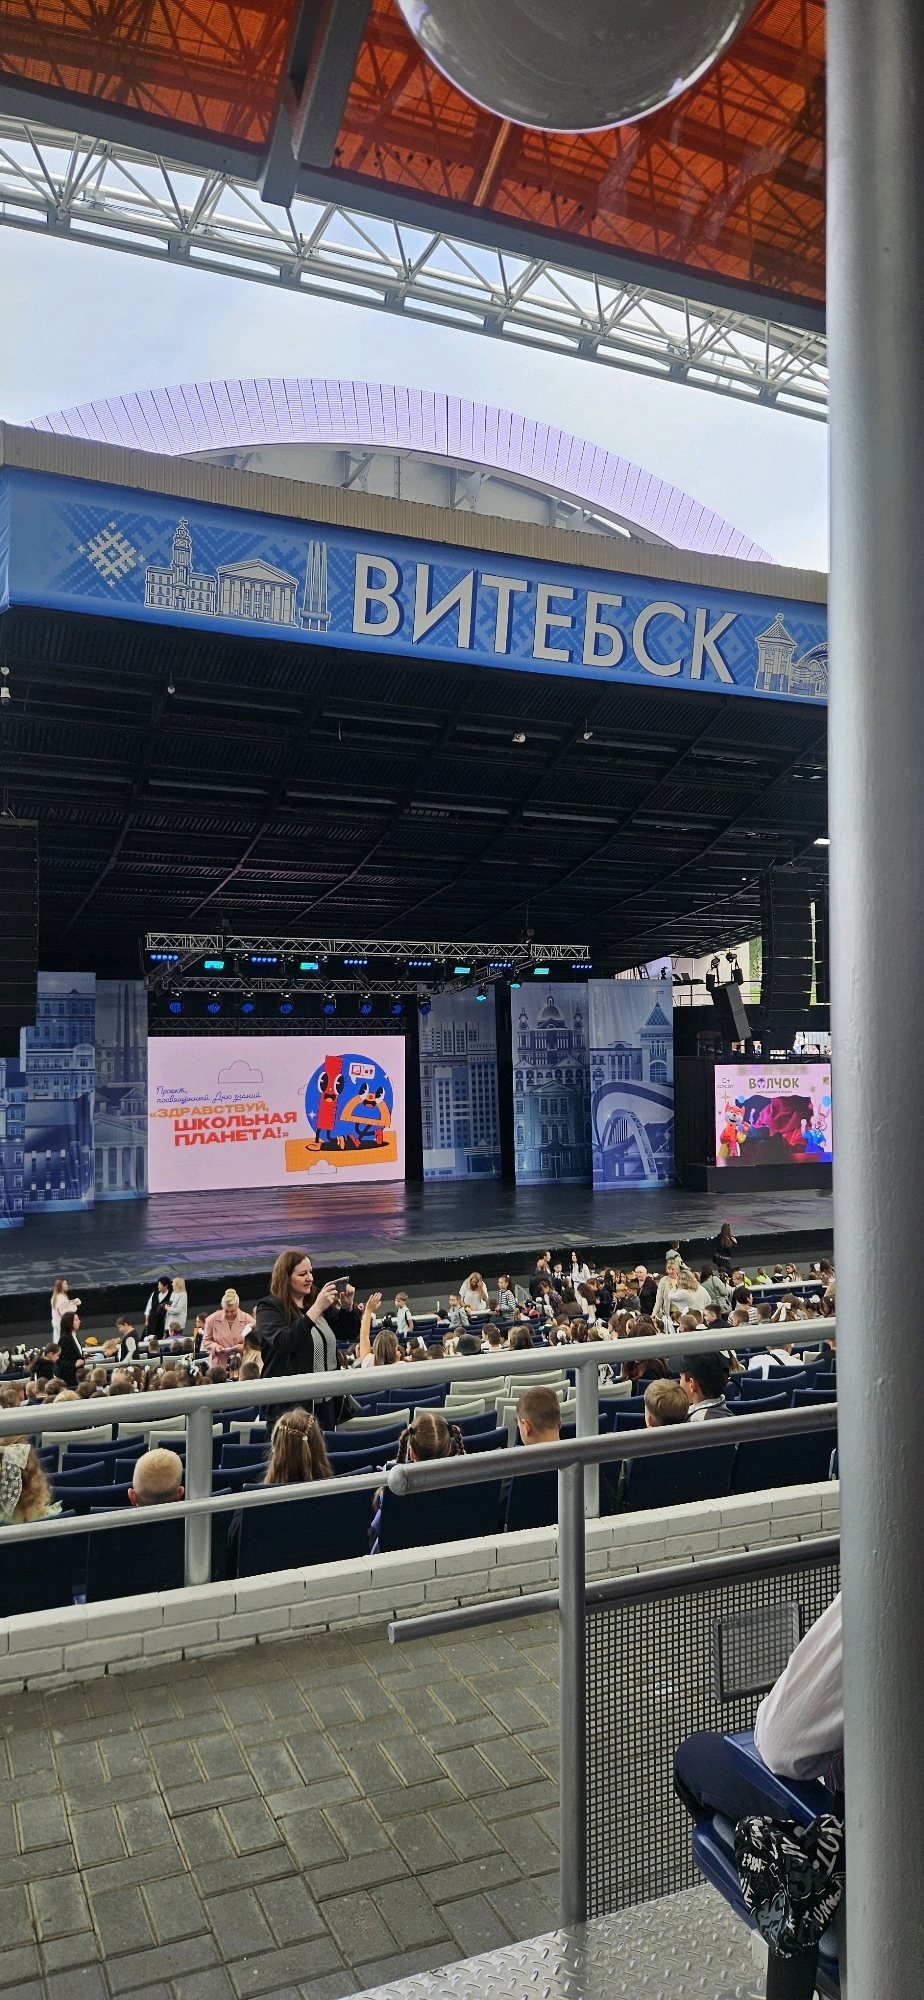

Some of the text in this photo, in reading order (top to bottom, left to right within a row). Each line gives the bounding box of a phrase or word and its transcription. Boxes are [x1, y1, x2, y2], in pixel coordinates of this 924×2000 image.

[352, 552, 740, 685] ВИТЕБСК
[156, 1085, 188, 1097] Проект,
[212, 1091, 232, 1104] Дню
[233, 1092, 262, 1103] знаний
[149, 1101, 270, 1118] «ЗДРАВСТВУЙ,
[174, 1111, 298, 1132] ШКОЛЬНАЯ
[174, 1127, 290, 1147] ПЛАНЕТА!»
